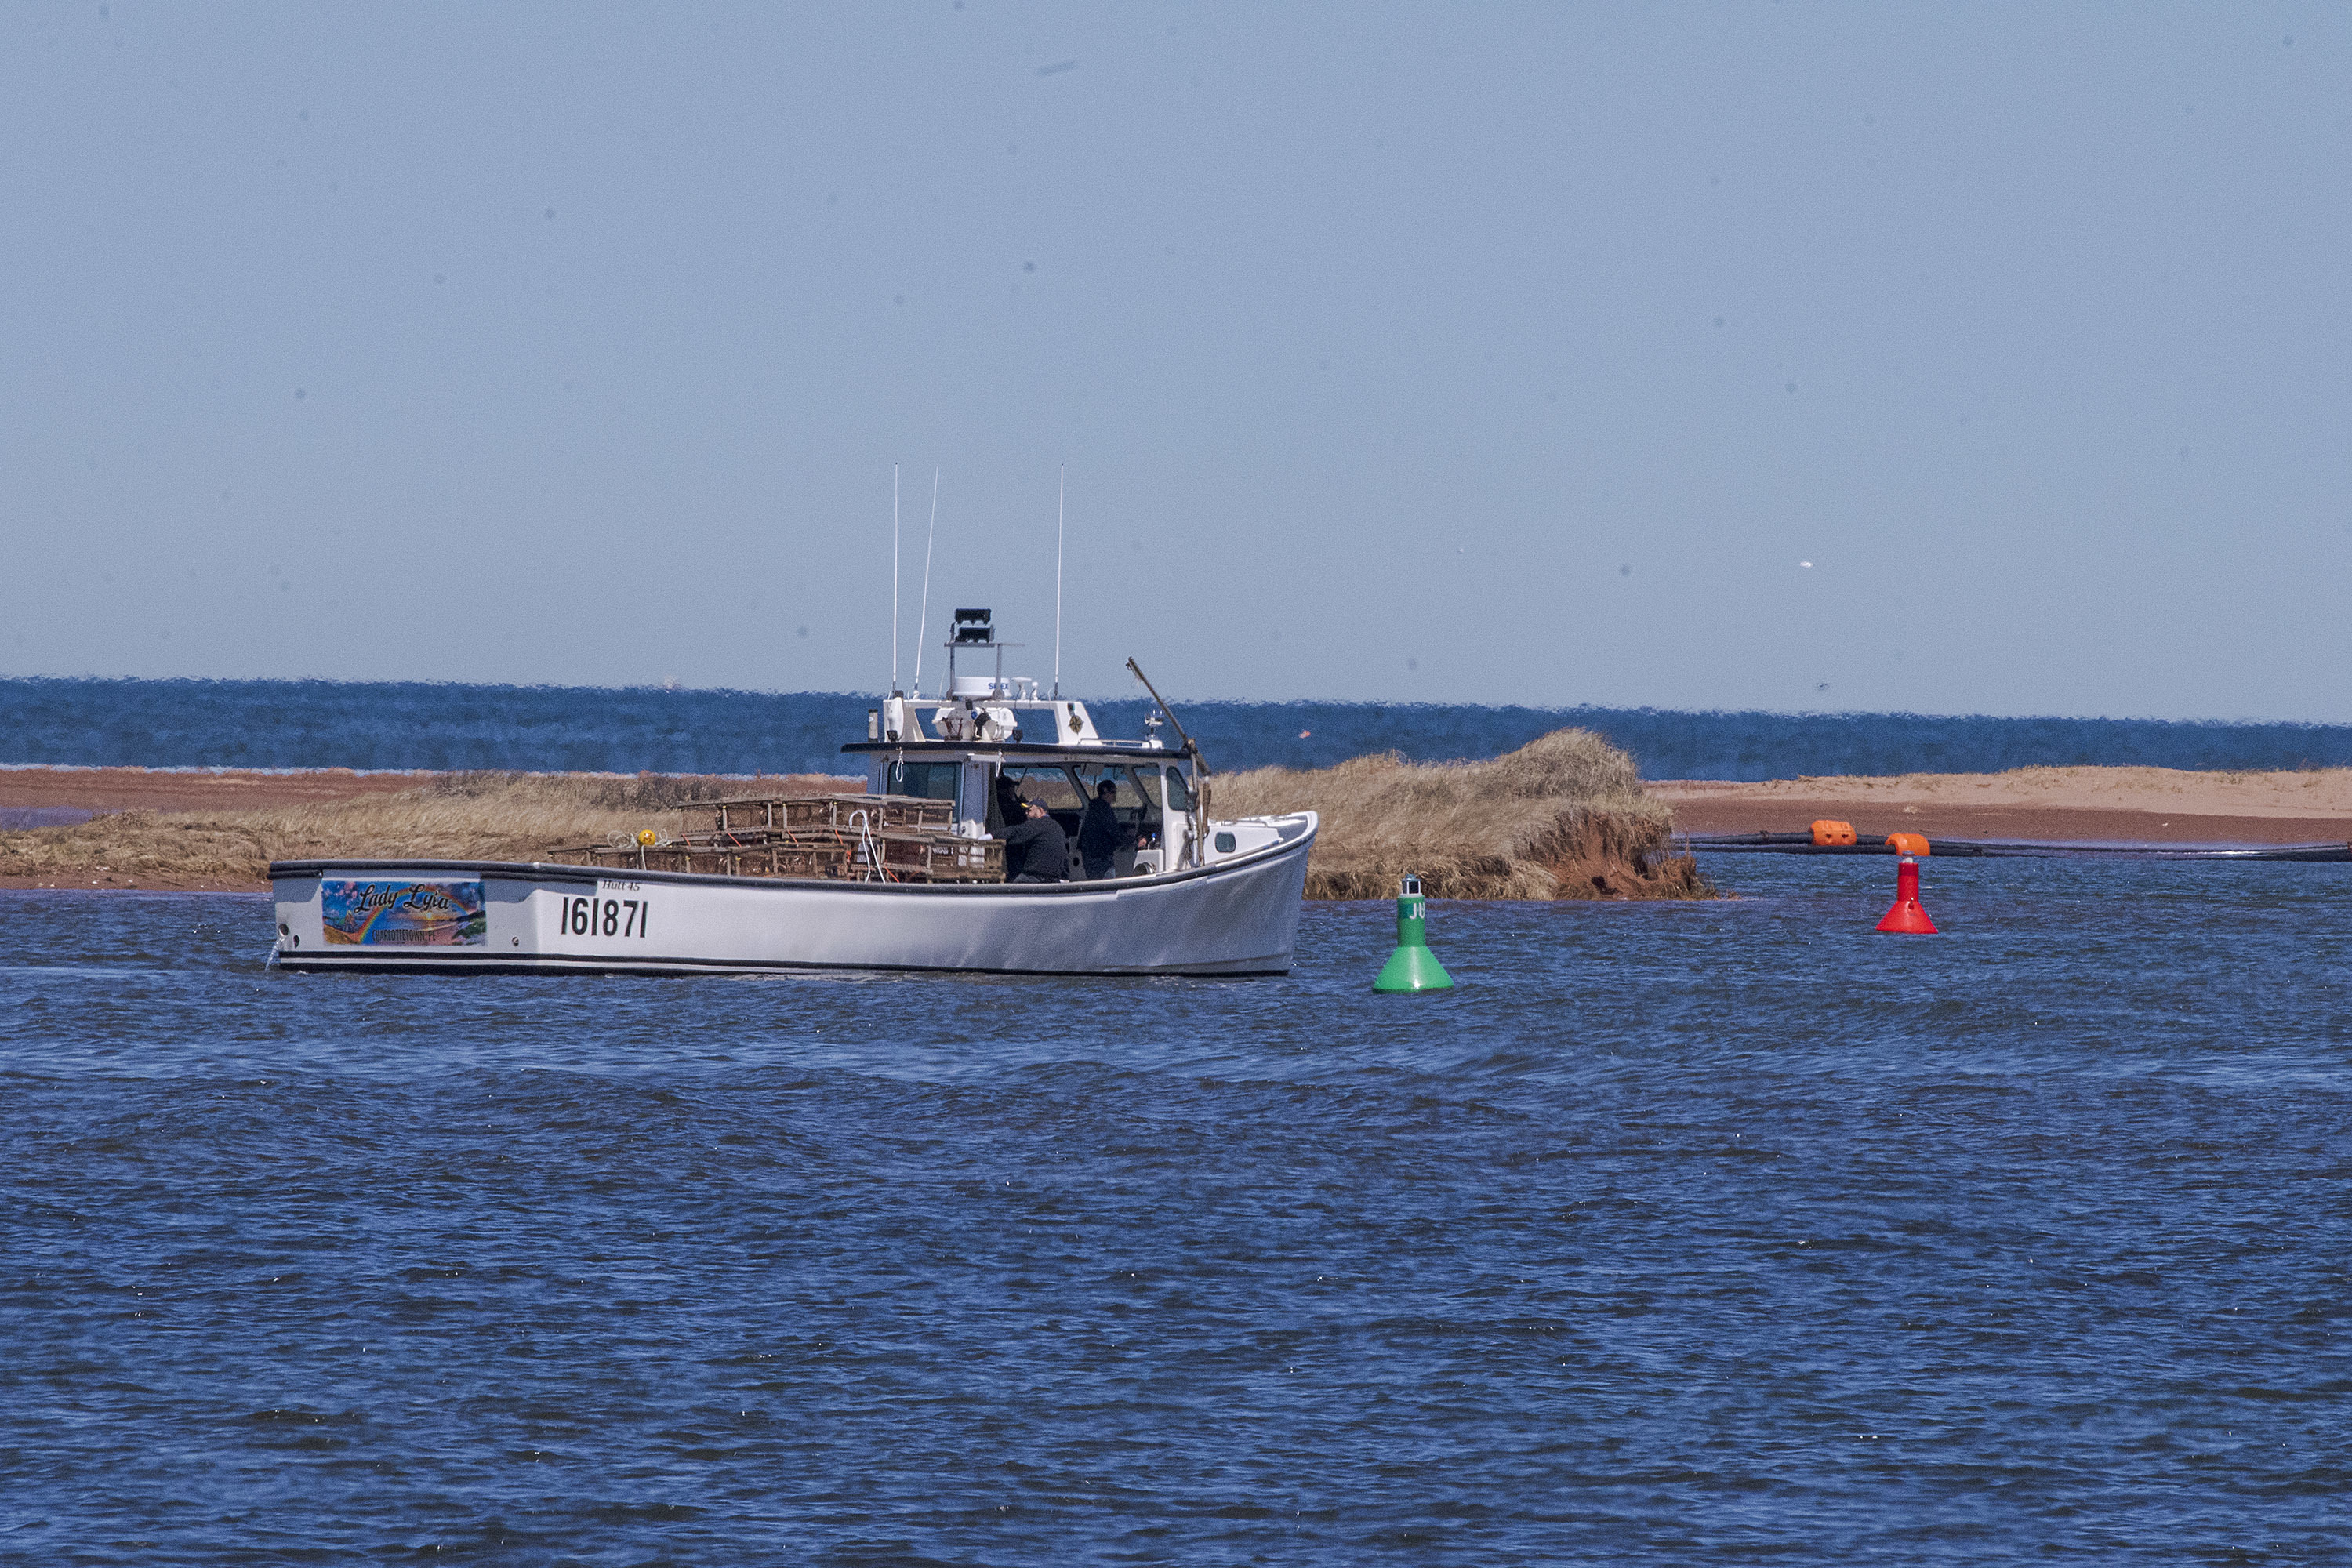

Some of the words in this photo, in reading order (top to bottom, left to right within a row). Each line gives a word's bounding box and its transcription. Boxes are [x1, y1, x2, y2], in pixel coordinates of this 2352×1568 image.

[354, 884, 398, 913] Lady
[627, 882, 640, 891] 45
[561, 897, 648, 938] 161871
